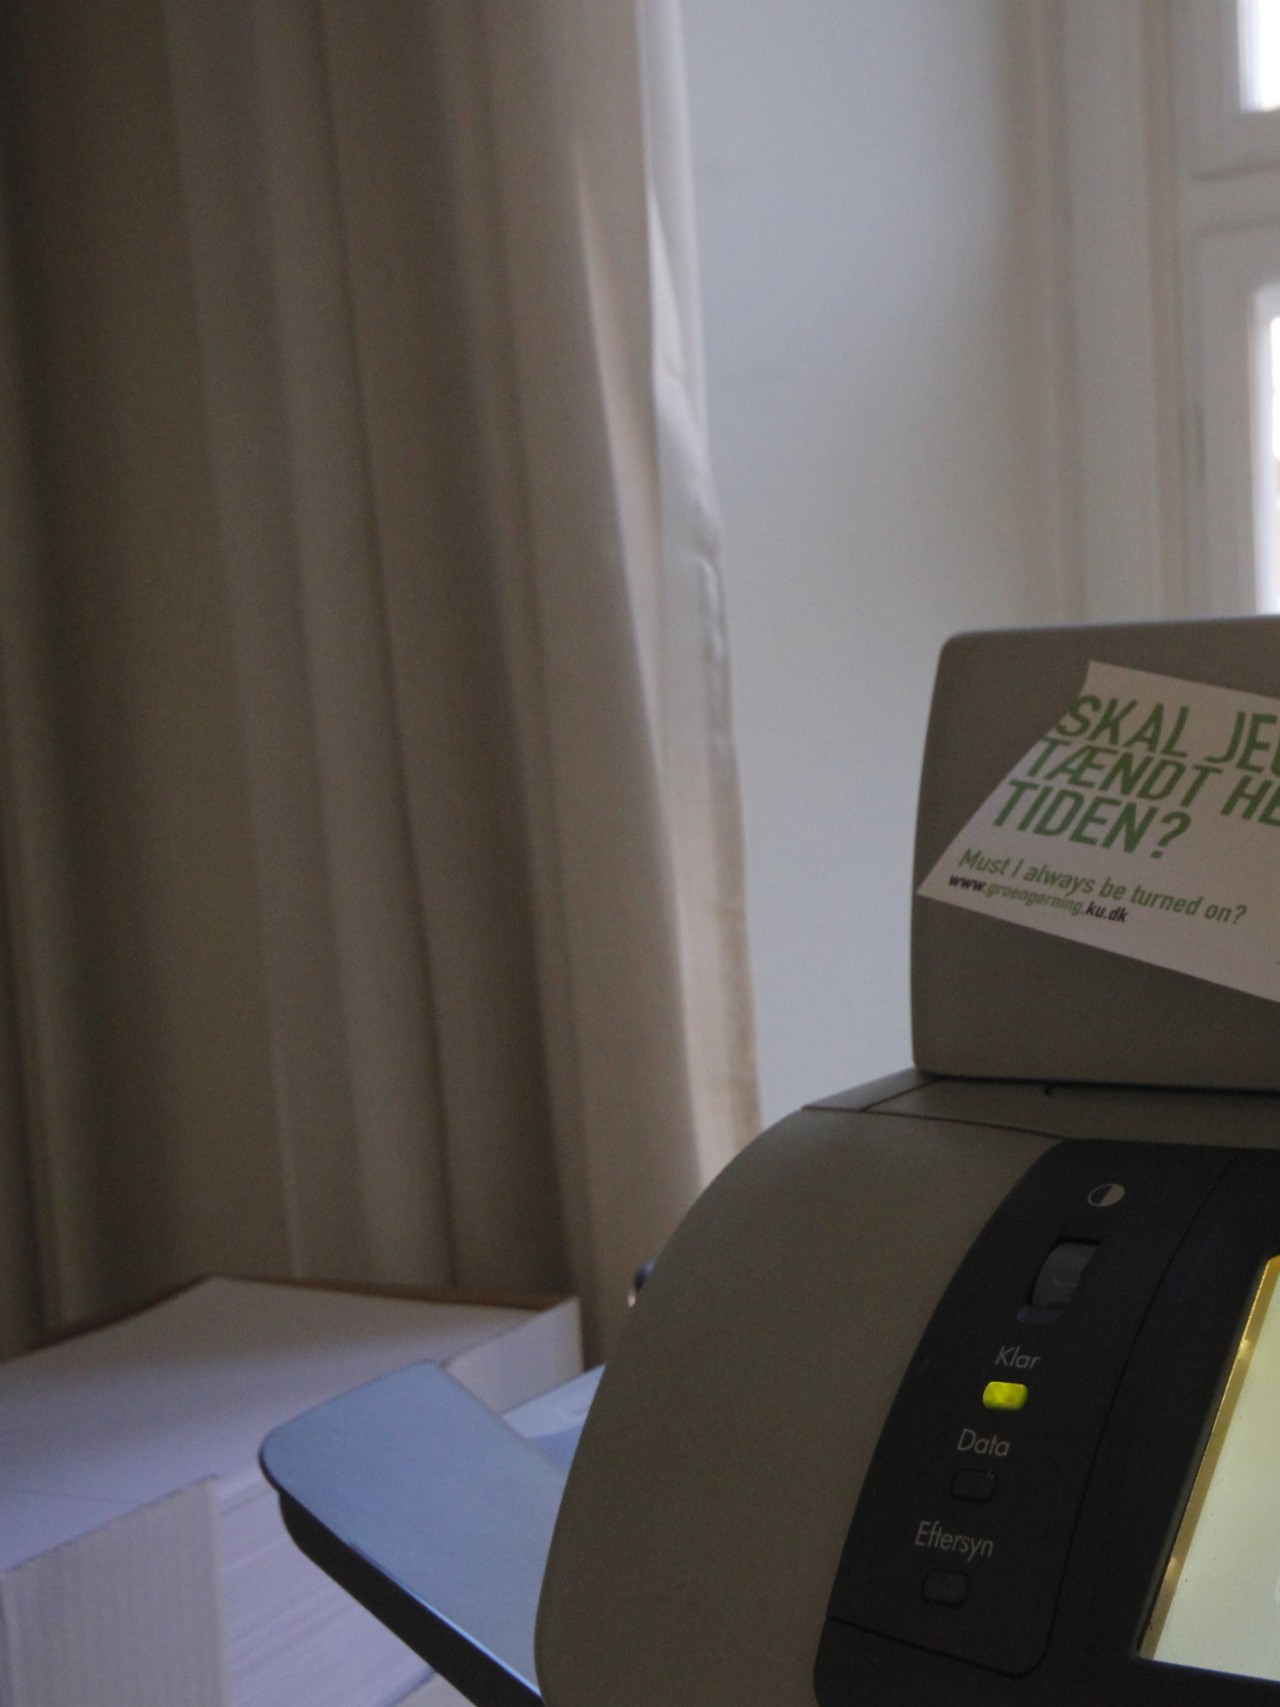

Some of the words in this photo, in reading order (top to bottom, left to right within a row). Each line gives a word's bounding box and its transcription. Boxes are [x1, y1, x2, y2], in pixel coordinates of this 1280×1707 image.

[1055, 694, 1189, 758] SKAL
[1024, 736, 1223, 808] TÆNDT
[993, 779, 1192, 860] TIDEN?
[957, 848, 1010, 876] Must
[1011, 858, 1025, 878] I
[1023, 865, 1097, 897] always
[1099, 877, 1127, 901] be
[1130, 884, 1204, 916] turned
[1203, 902, 1247, 925] on?
[994, 1343, 1042, 1371] Klar
[956, 1427, 1011, 1458] Data
[913, 1520, 995, 1563] Eftersyn
